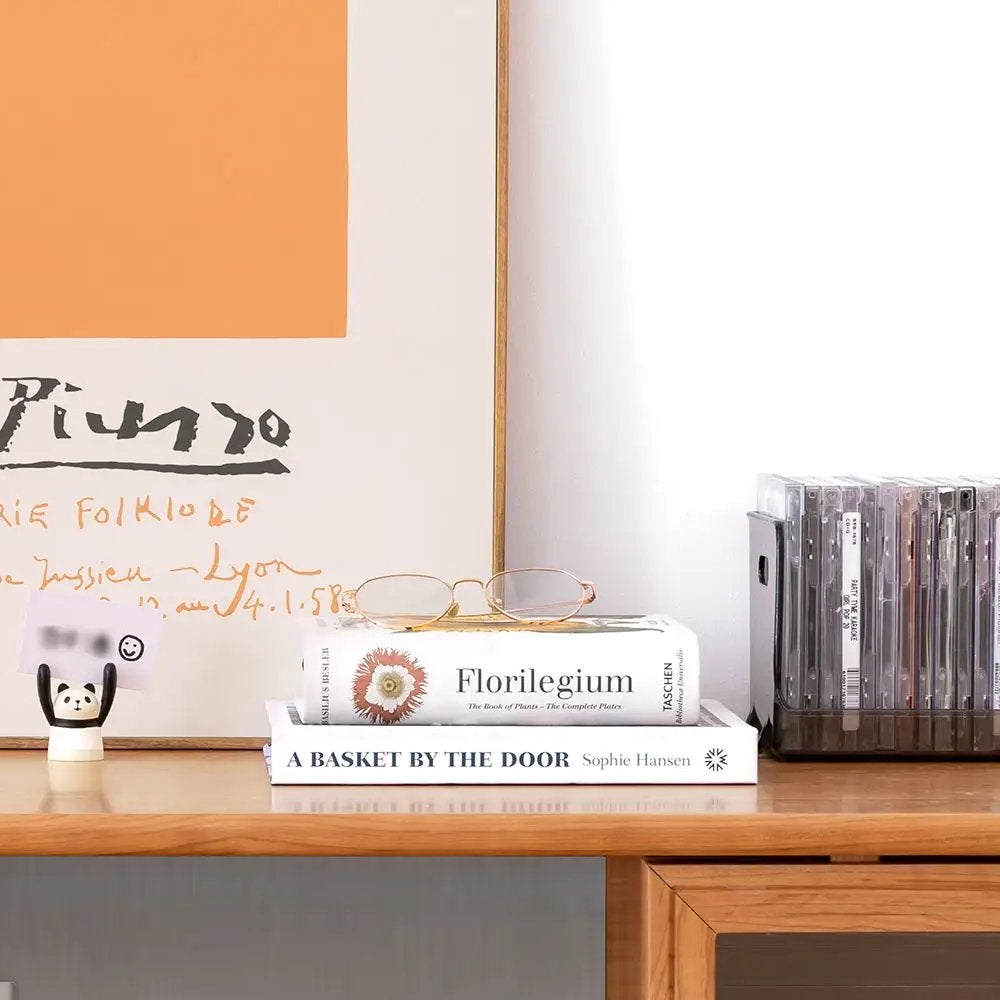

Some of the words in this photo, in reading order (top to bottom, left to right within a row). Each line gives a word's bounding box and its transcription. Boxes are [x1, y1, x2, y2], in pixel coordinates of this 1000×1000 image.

[203, 543, 322, 617] Lyon
[321, 647, 329, 684] BESLER
[456, 668, 635, 700] Florilegium
[662, 662, 673, 712] TASCHEN
[321, 687, 329, 725] BASILIUS
[505, 703, 514, 711] of
[561, 703, 598, 711] Complete
[675, 688, 684, 724] Bibliotheca
[286, 751, 303, 768] A
[310, 751, 402, 768] BASKET
[409, 751, 439, 768] BY
[444, 751, 493, 768] THE
[501, 751, 570, 768] DOOR
[582, 752, 631, 770] Sophie
[636, 752, 691, 767] Hansen
